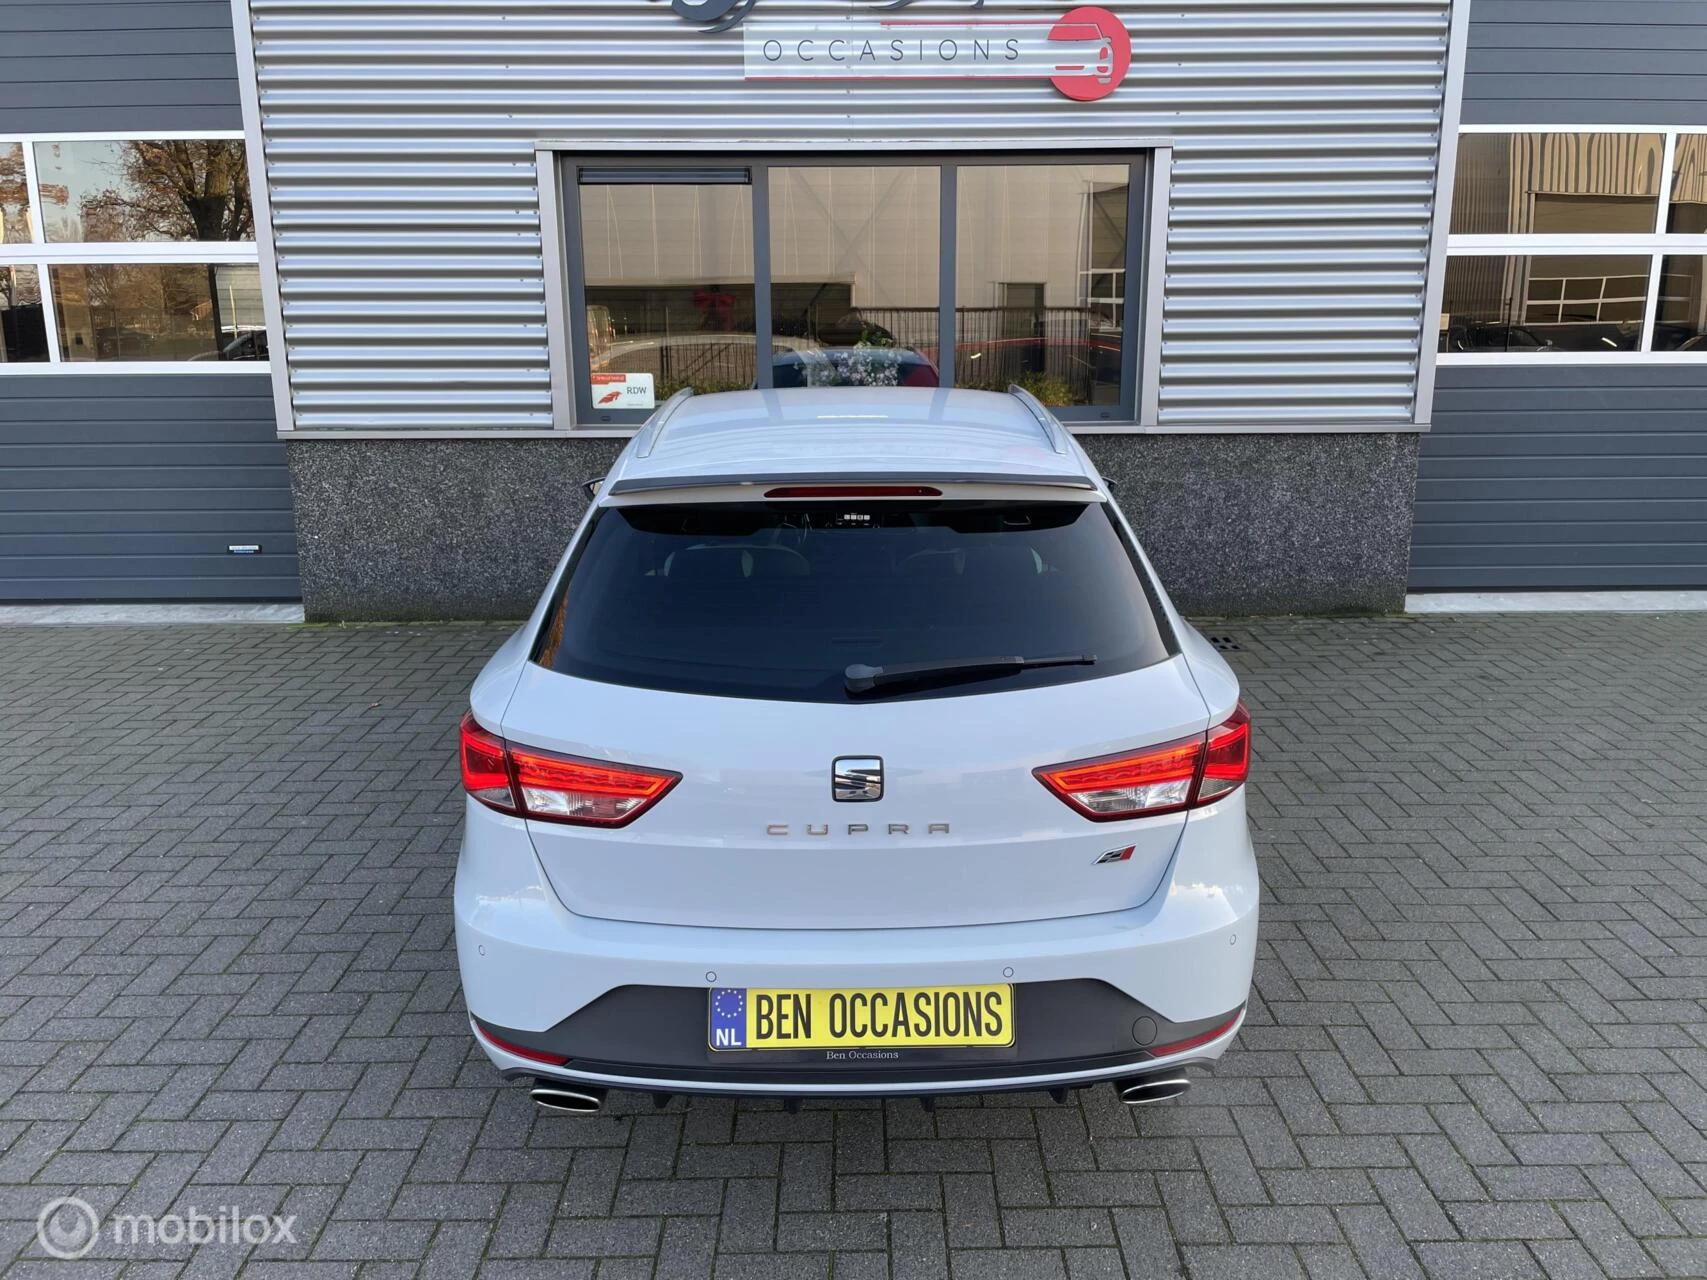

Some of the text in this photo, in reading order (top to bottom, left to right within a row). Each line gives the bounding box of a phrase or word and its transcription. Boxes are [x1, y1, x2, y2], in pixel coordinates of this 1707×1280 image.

[763, 39, 1019, 61] OCCASIONS
[626, 386, 647, 395] RDW
[766, 823, 950, 836] CUPRA
[755, 991, 1003, 1039] BEN OCCASIONS
[715, 1028, 742, 1046] NL
[826, 1050, 899, 1060] Ben Occasions
